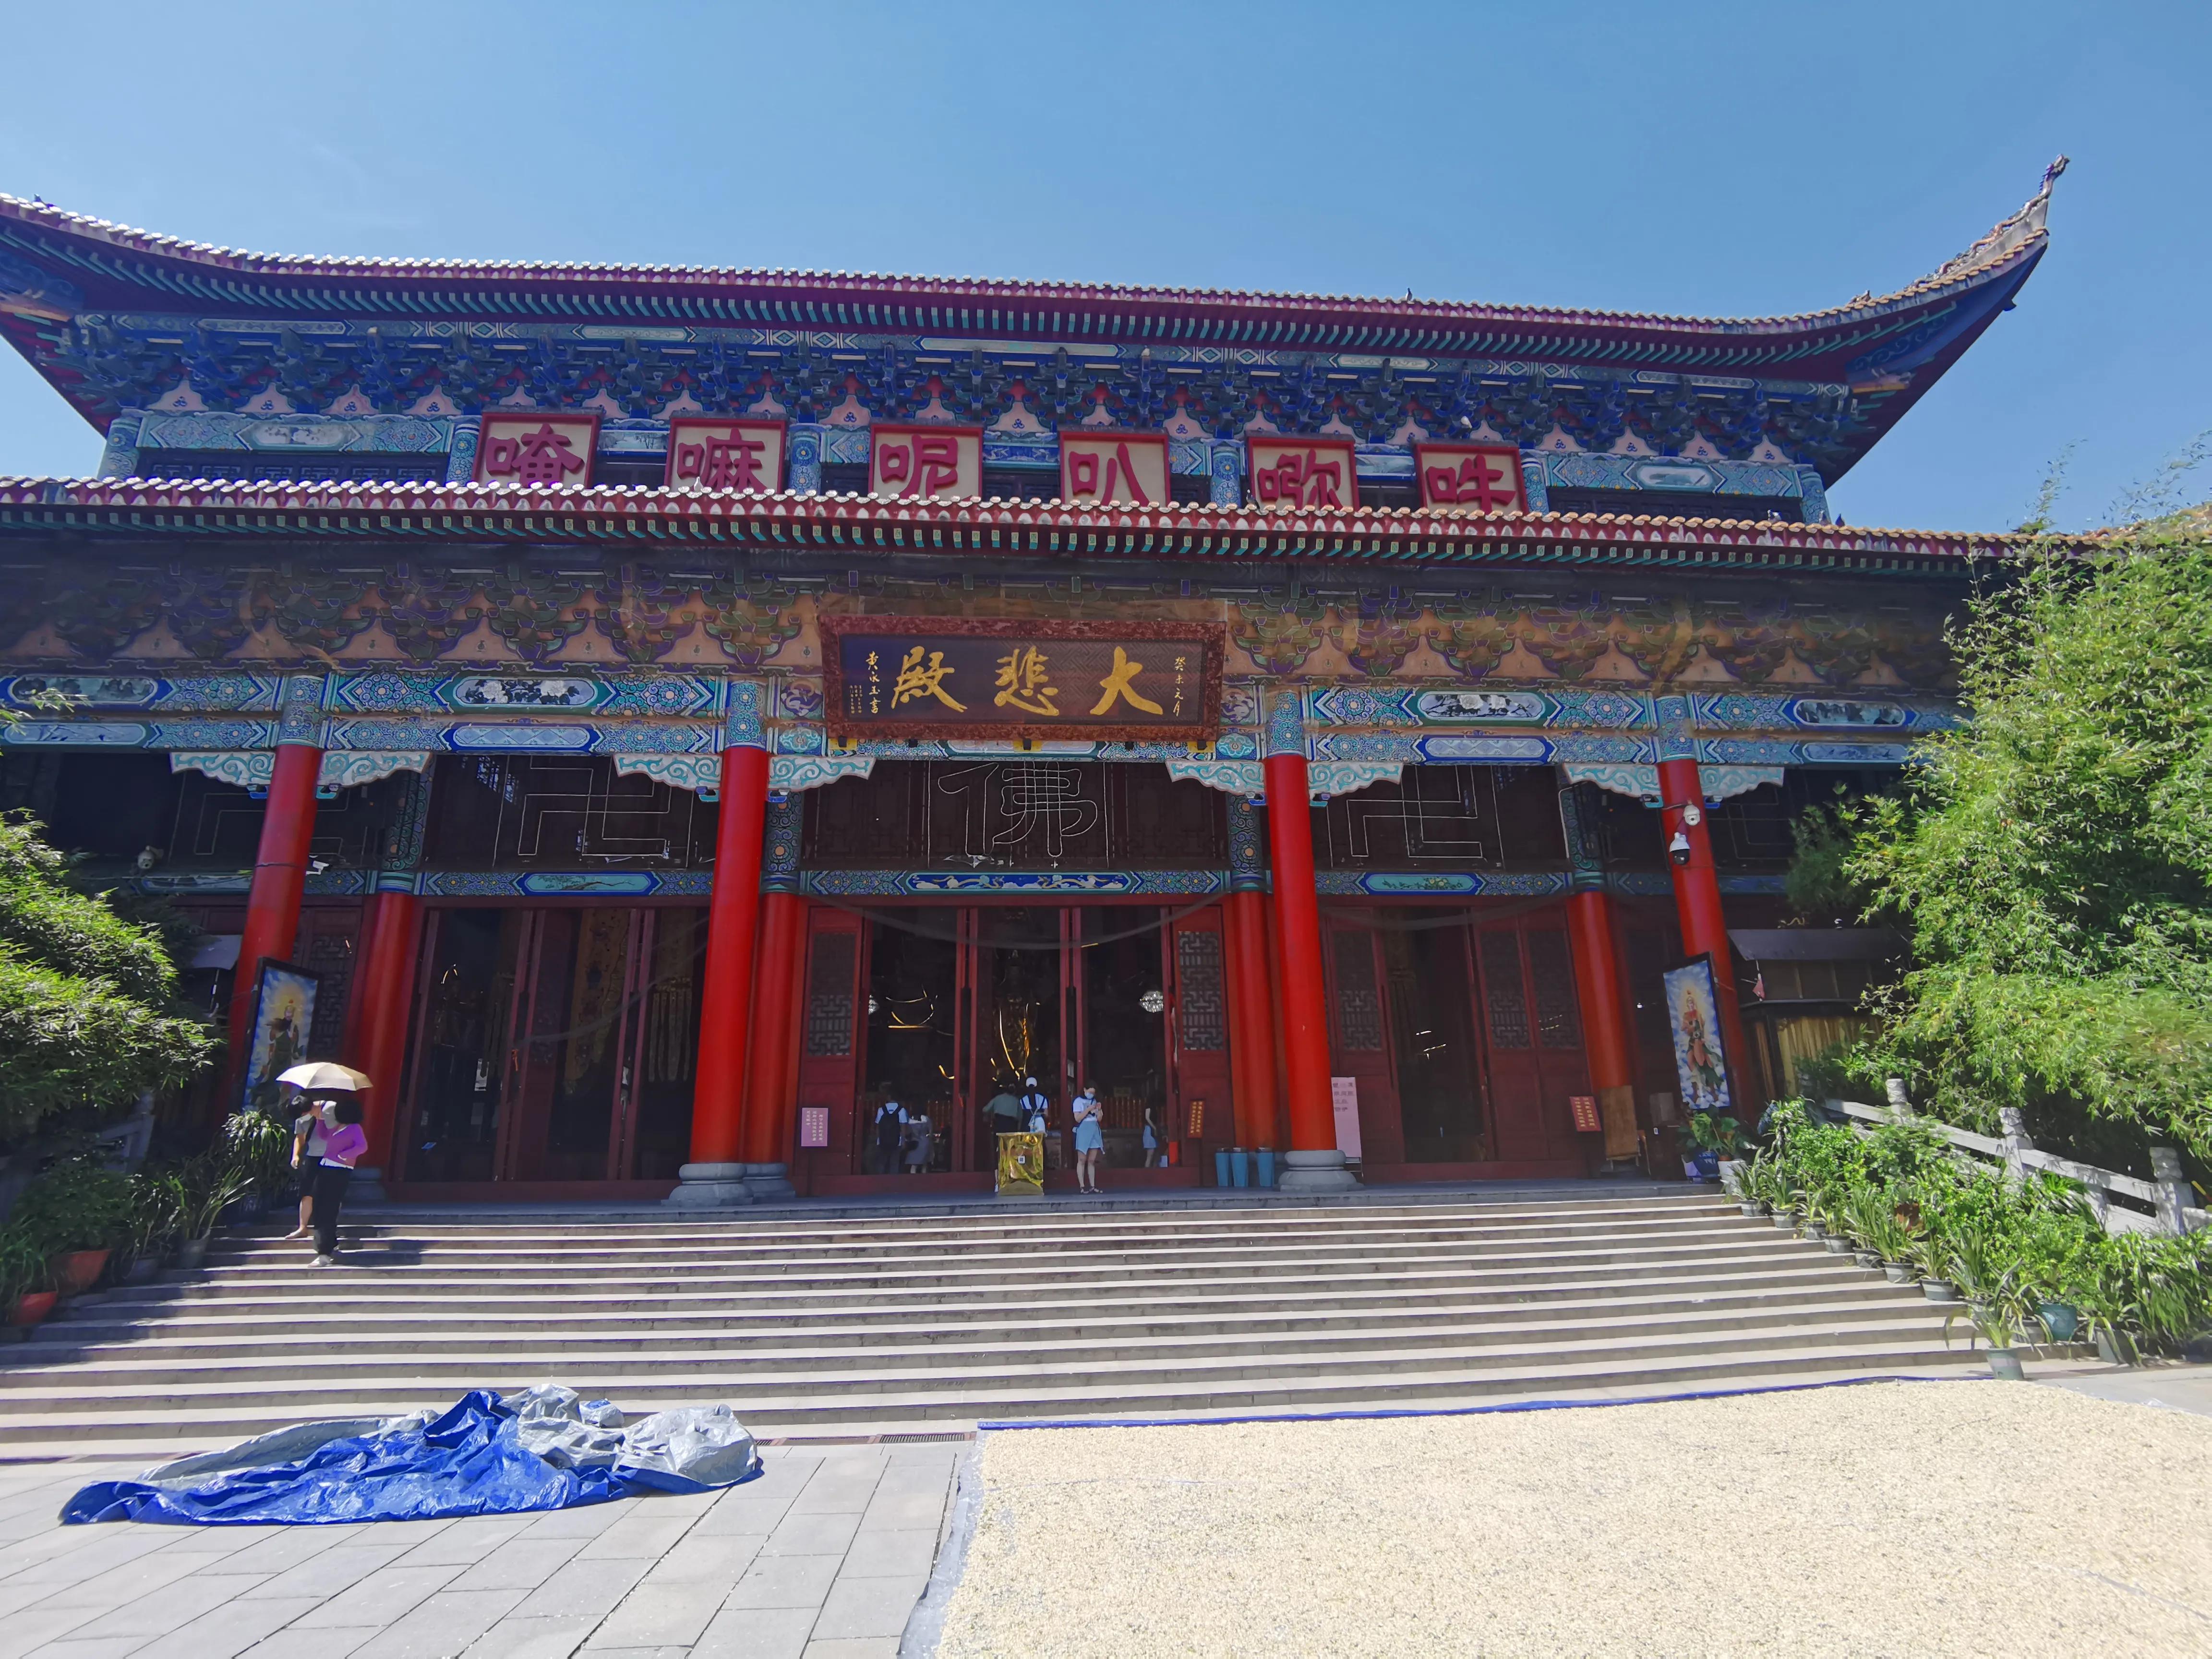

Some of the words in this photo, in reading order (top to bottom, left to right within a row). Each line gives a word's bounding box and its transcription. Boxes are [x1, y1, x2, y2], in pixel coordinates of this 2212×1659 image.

[677, 427, 769, 493] 嘛
[879, 434, 973, 500] 呢
[1069, 442, 1150, 507] 叭
[891, 646, 1163, 716] 大悲殿
